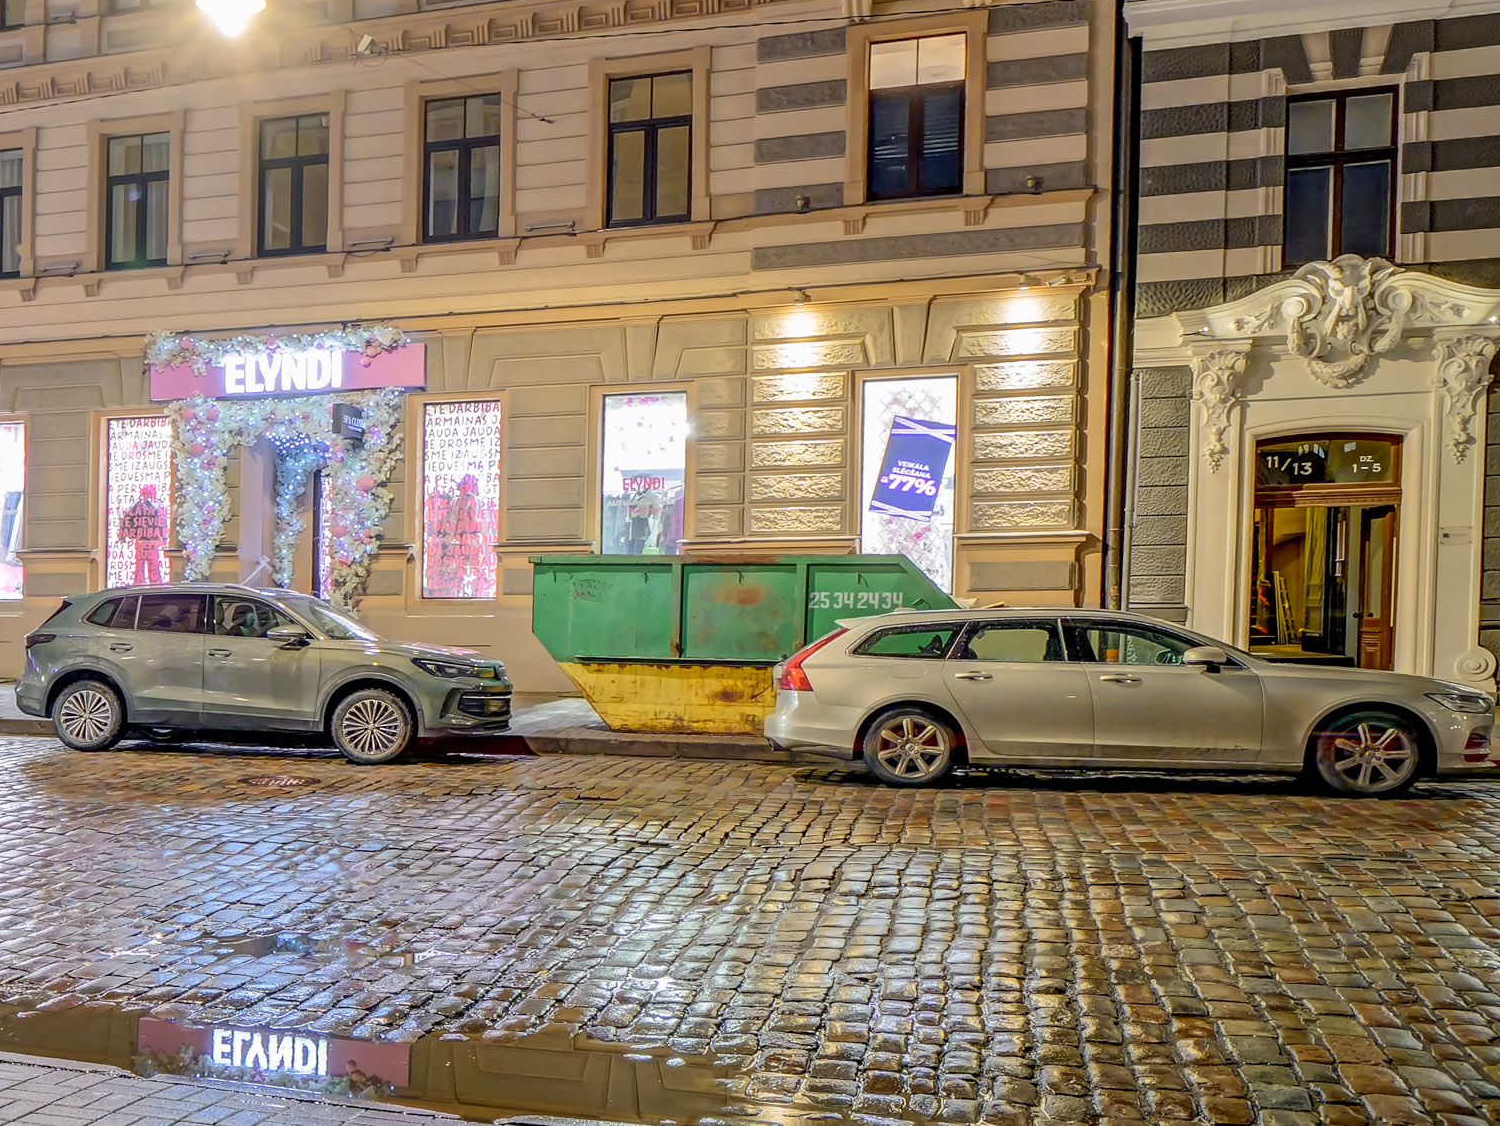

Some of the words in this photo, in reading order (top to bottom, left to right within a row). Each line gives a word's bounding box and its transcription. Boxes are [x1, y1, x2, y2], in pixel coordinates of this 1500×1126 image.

[225, 350, 343, 394] ELYNDI
[462, 427, 500, 437] JAUDA
[439, 438, 486, 449] DROSME
[122, 451, 162, 461] DROSME
[897, 459, 930, 472] VEIKALA
[1266, 455, 1313, 475] 11/13
[623, 477, 665, 491] ELYNDI
[808, 592, 830, 609] 25
[833, 592, 854, 609] 34
[857, 592, 879, 609] 24
[882, 592, 903, 609] 34
